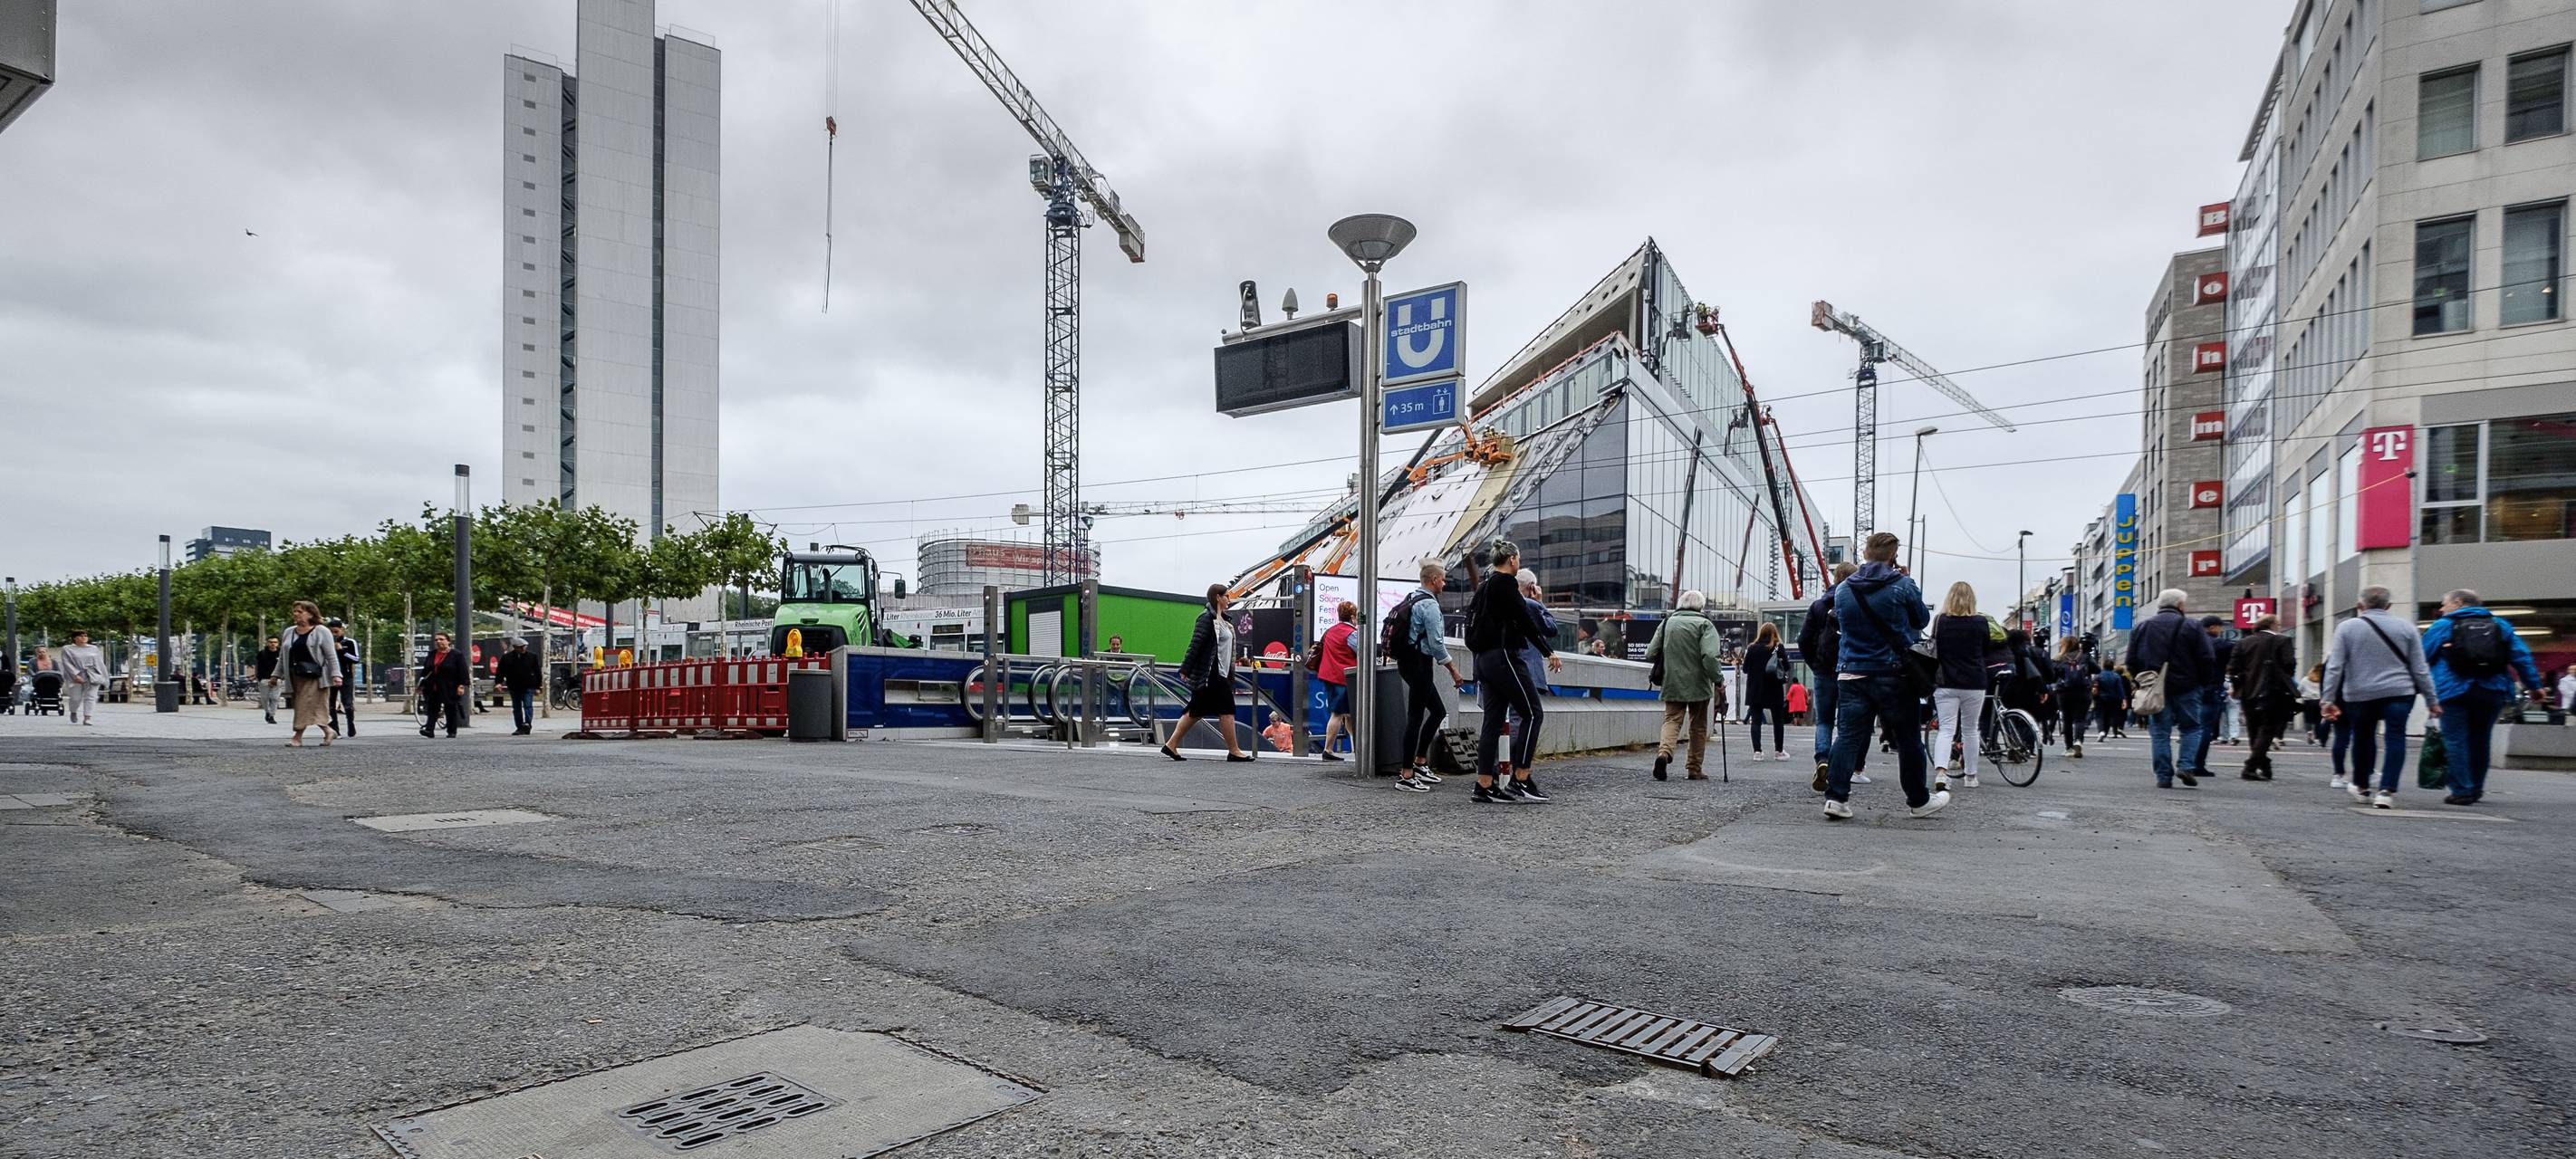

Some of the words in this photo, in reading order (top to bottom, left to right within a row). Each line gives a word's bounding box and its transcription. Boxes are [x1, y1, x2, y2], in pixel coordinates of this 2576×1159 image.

[1390, 319, 1452, 338] stadtbahn
[1397, 297, 1446, 369] U
[1400, 403, 1413, 414] 35
[1415, 402, 1424, 411] m
[2372, 430, 2408, 461] T
[1319, 583, 1340, 593] Open
[1319, 594, 1345, 603] Source
[887, 613, 899, 621] Liter
[935, 610, 943, 618] 36
[943, 609, 956, 618] Mio.
[957, 609, 972, 618] Liter
[1319, 605, 1337, 614] Festi
